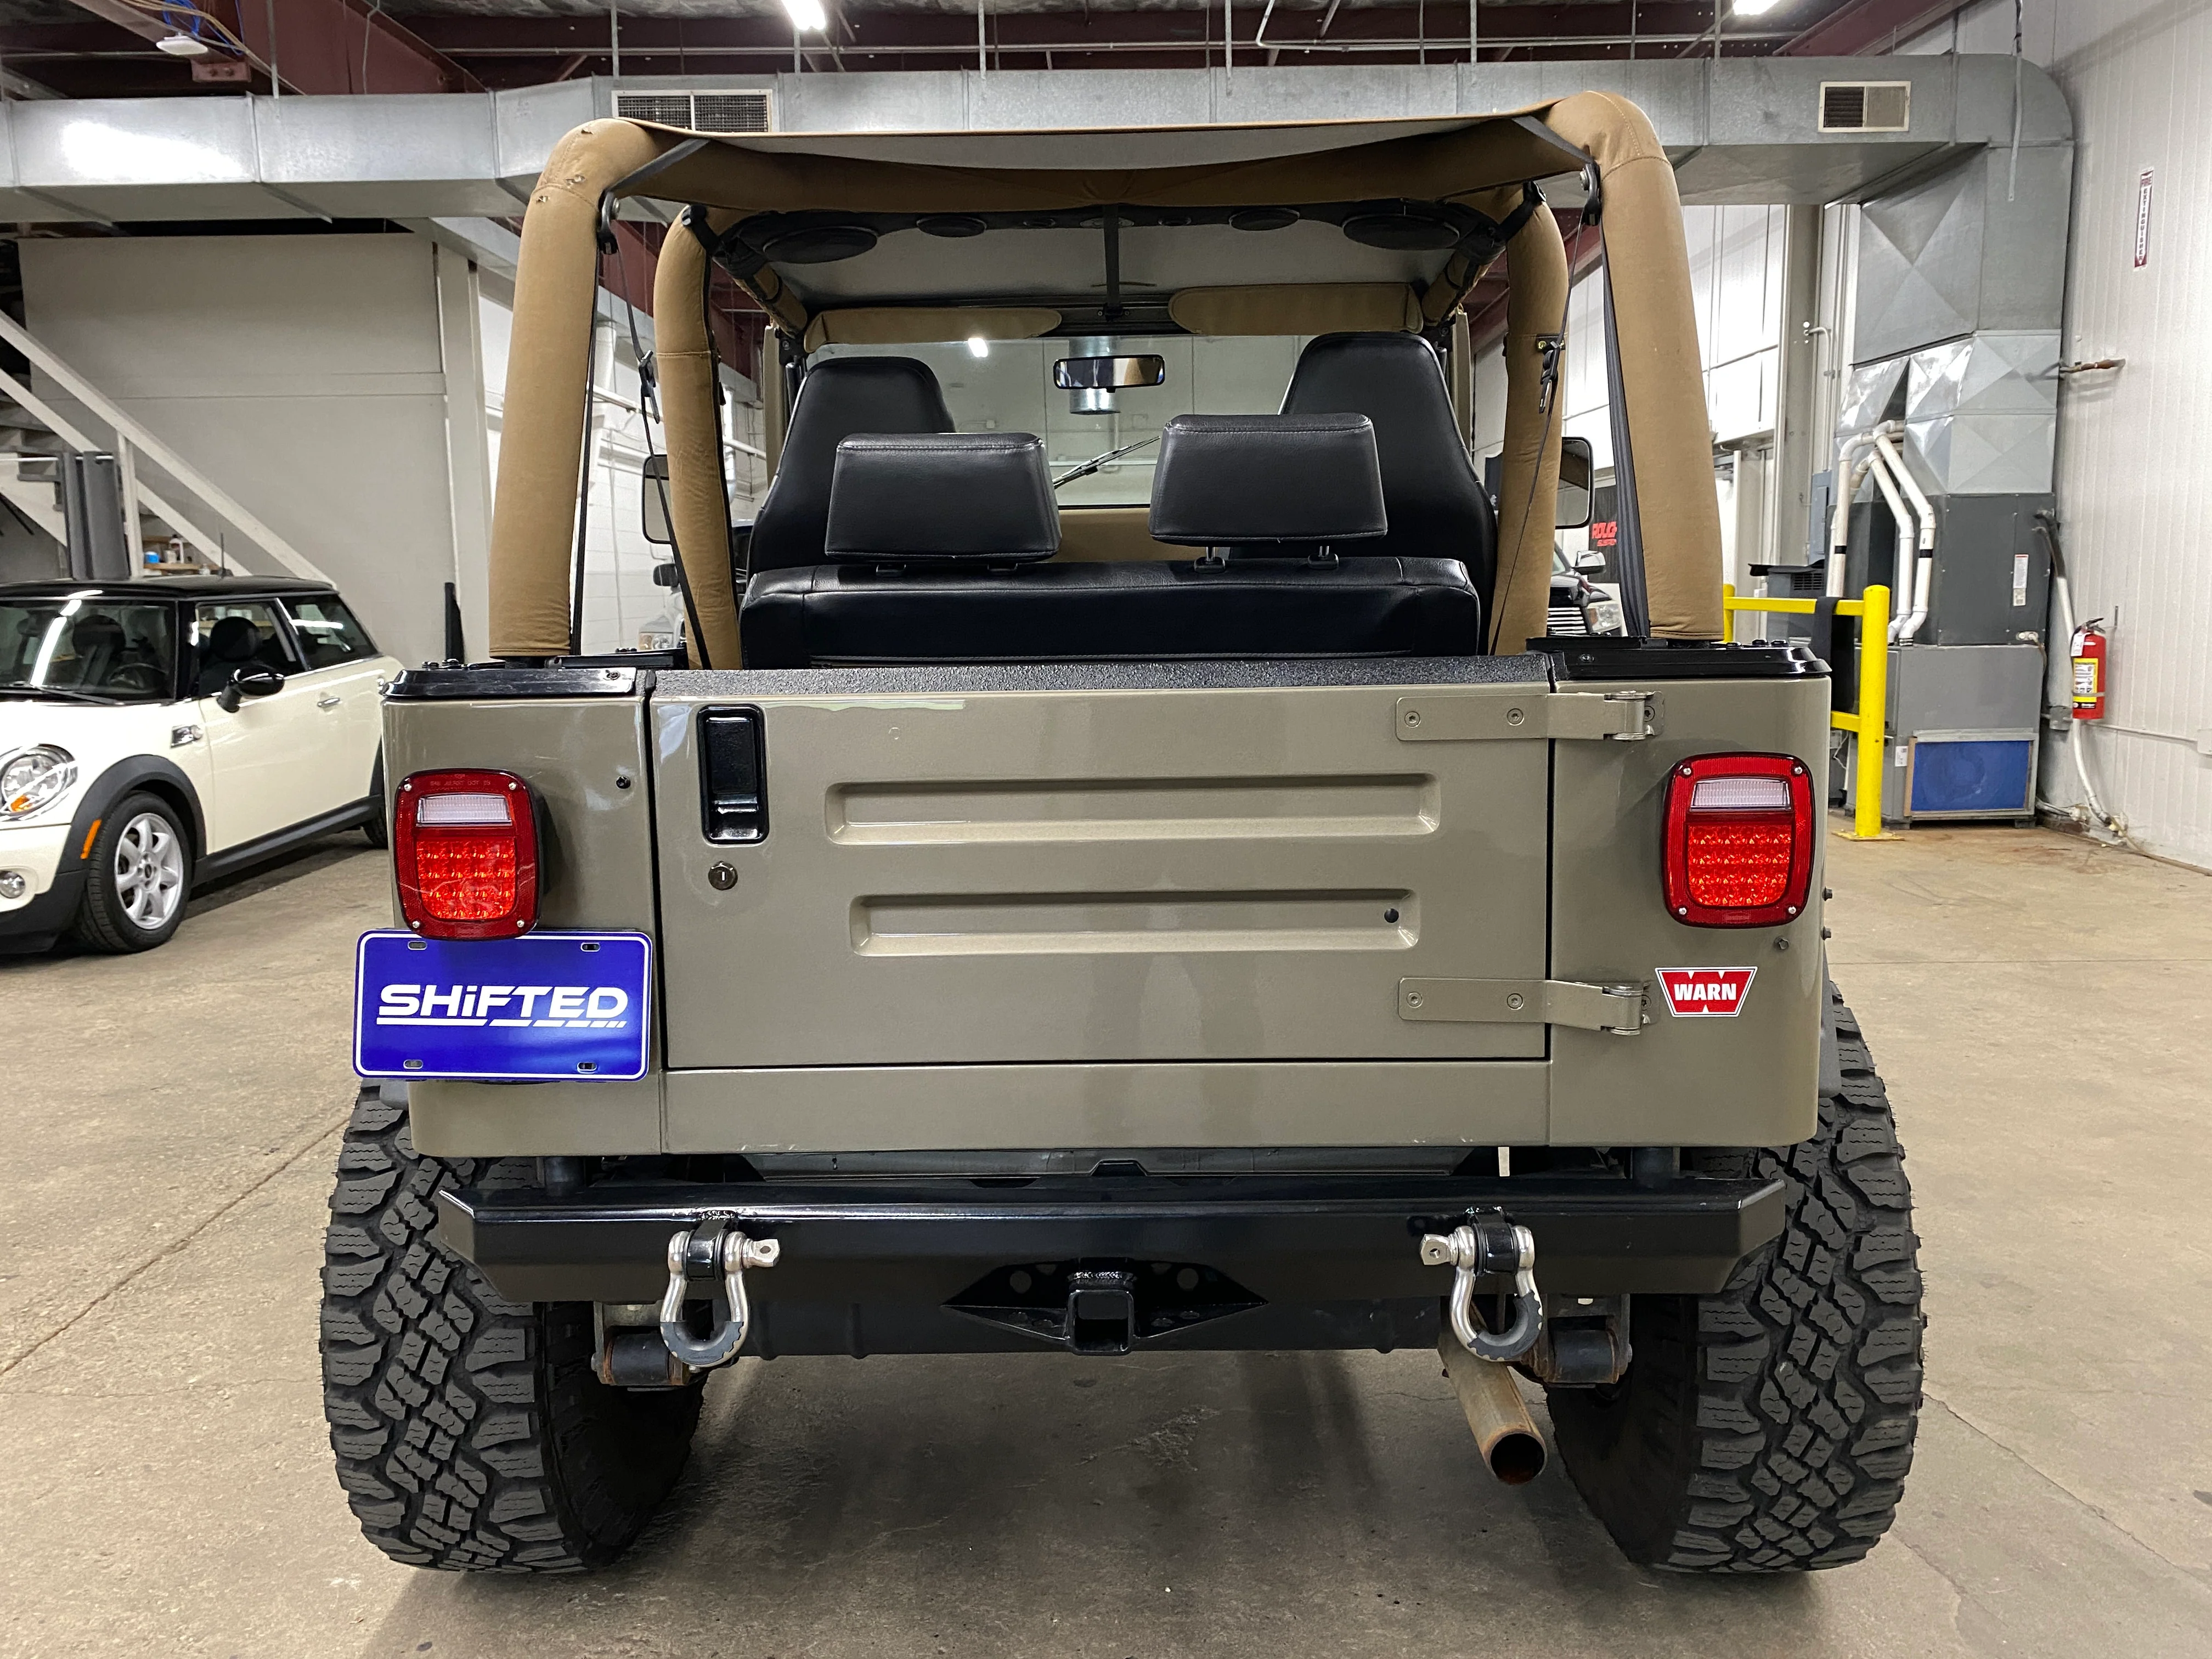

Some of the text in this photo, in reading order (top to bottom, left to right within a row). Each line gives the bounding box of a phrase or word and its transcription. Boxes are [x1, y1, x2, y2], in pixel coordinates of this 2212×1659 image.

[2139, 188, 2147, 261] EXTINGUISHER
[1592, 521, 1617, 539] ROUG
[1674, 983, 1737, 1001] WARN
